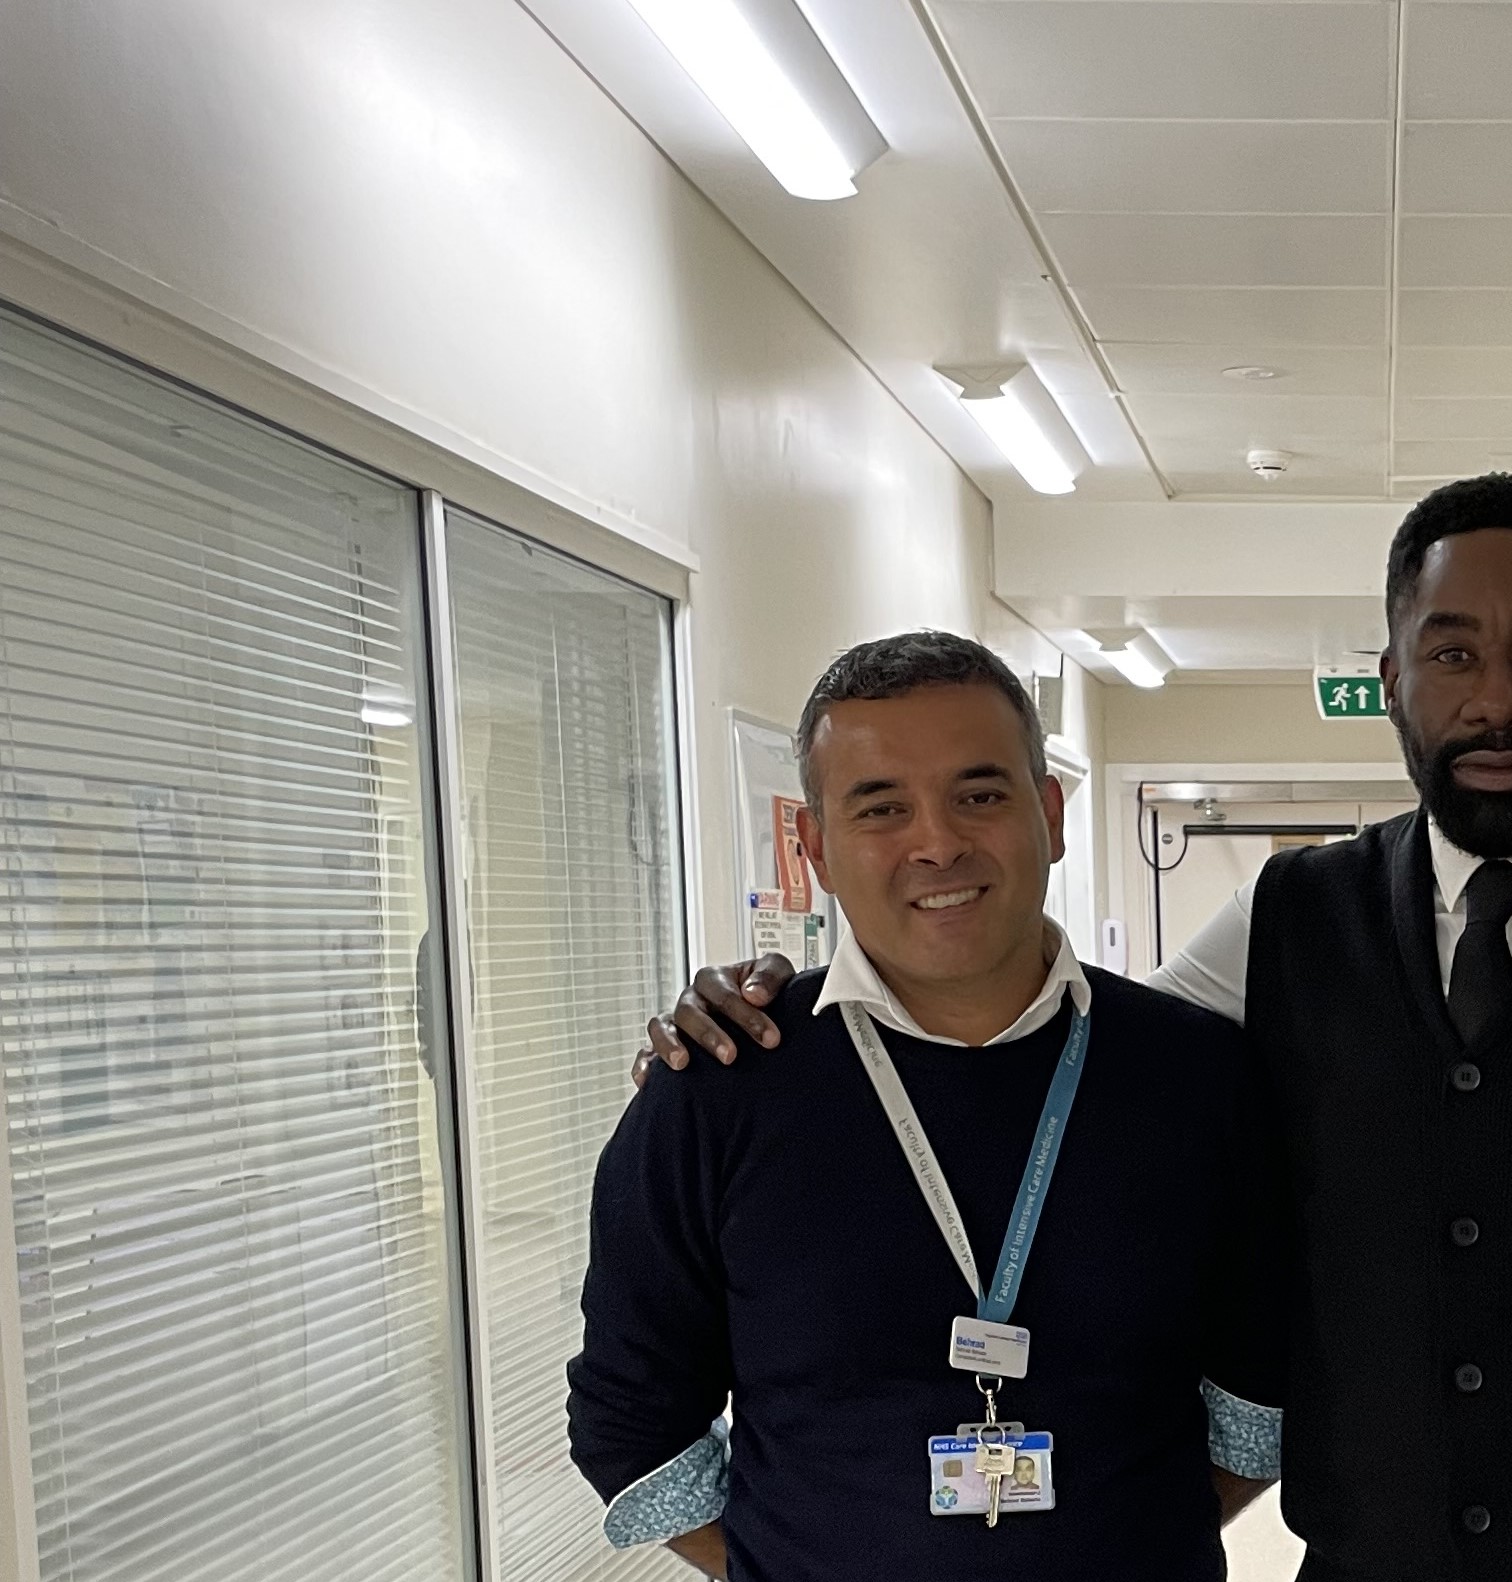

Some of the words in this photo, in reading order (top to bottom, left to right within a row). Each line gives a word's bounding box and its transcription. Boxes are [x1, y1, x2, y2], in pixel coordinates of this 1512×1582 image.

[1066, 1027, 1085, 1066] Faculty
[1035, 1116, 1059, 1168] Medicine
[1028, 1168, 1044, 1194] Care
[1013, 1195, 1036, 1246] Intensive
[1009, 1247, 1020, 1261] of
[995, 1260, 1018, 1303] Faculty
[950, 1442, 966, 1450] Care
